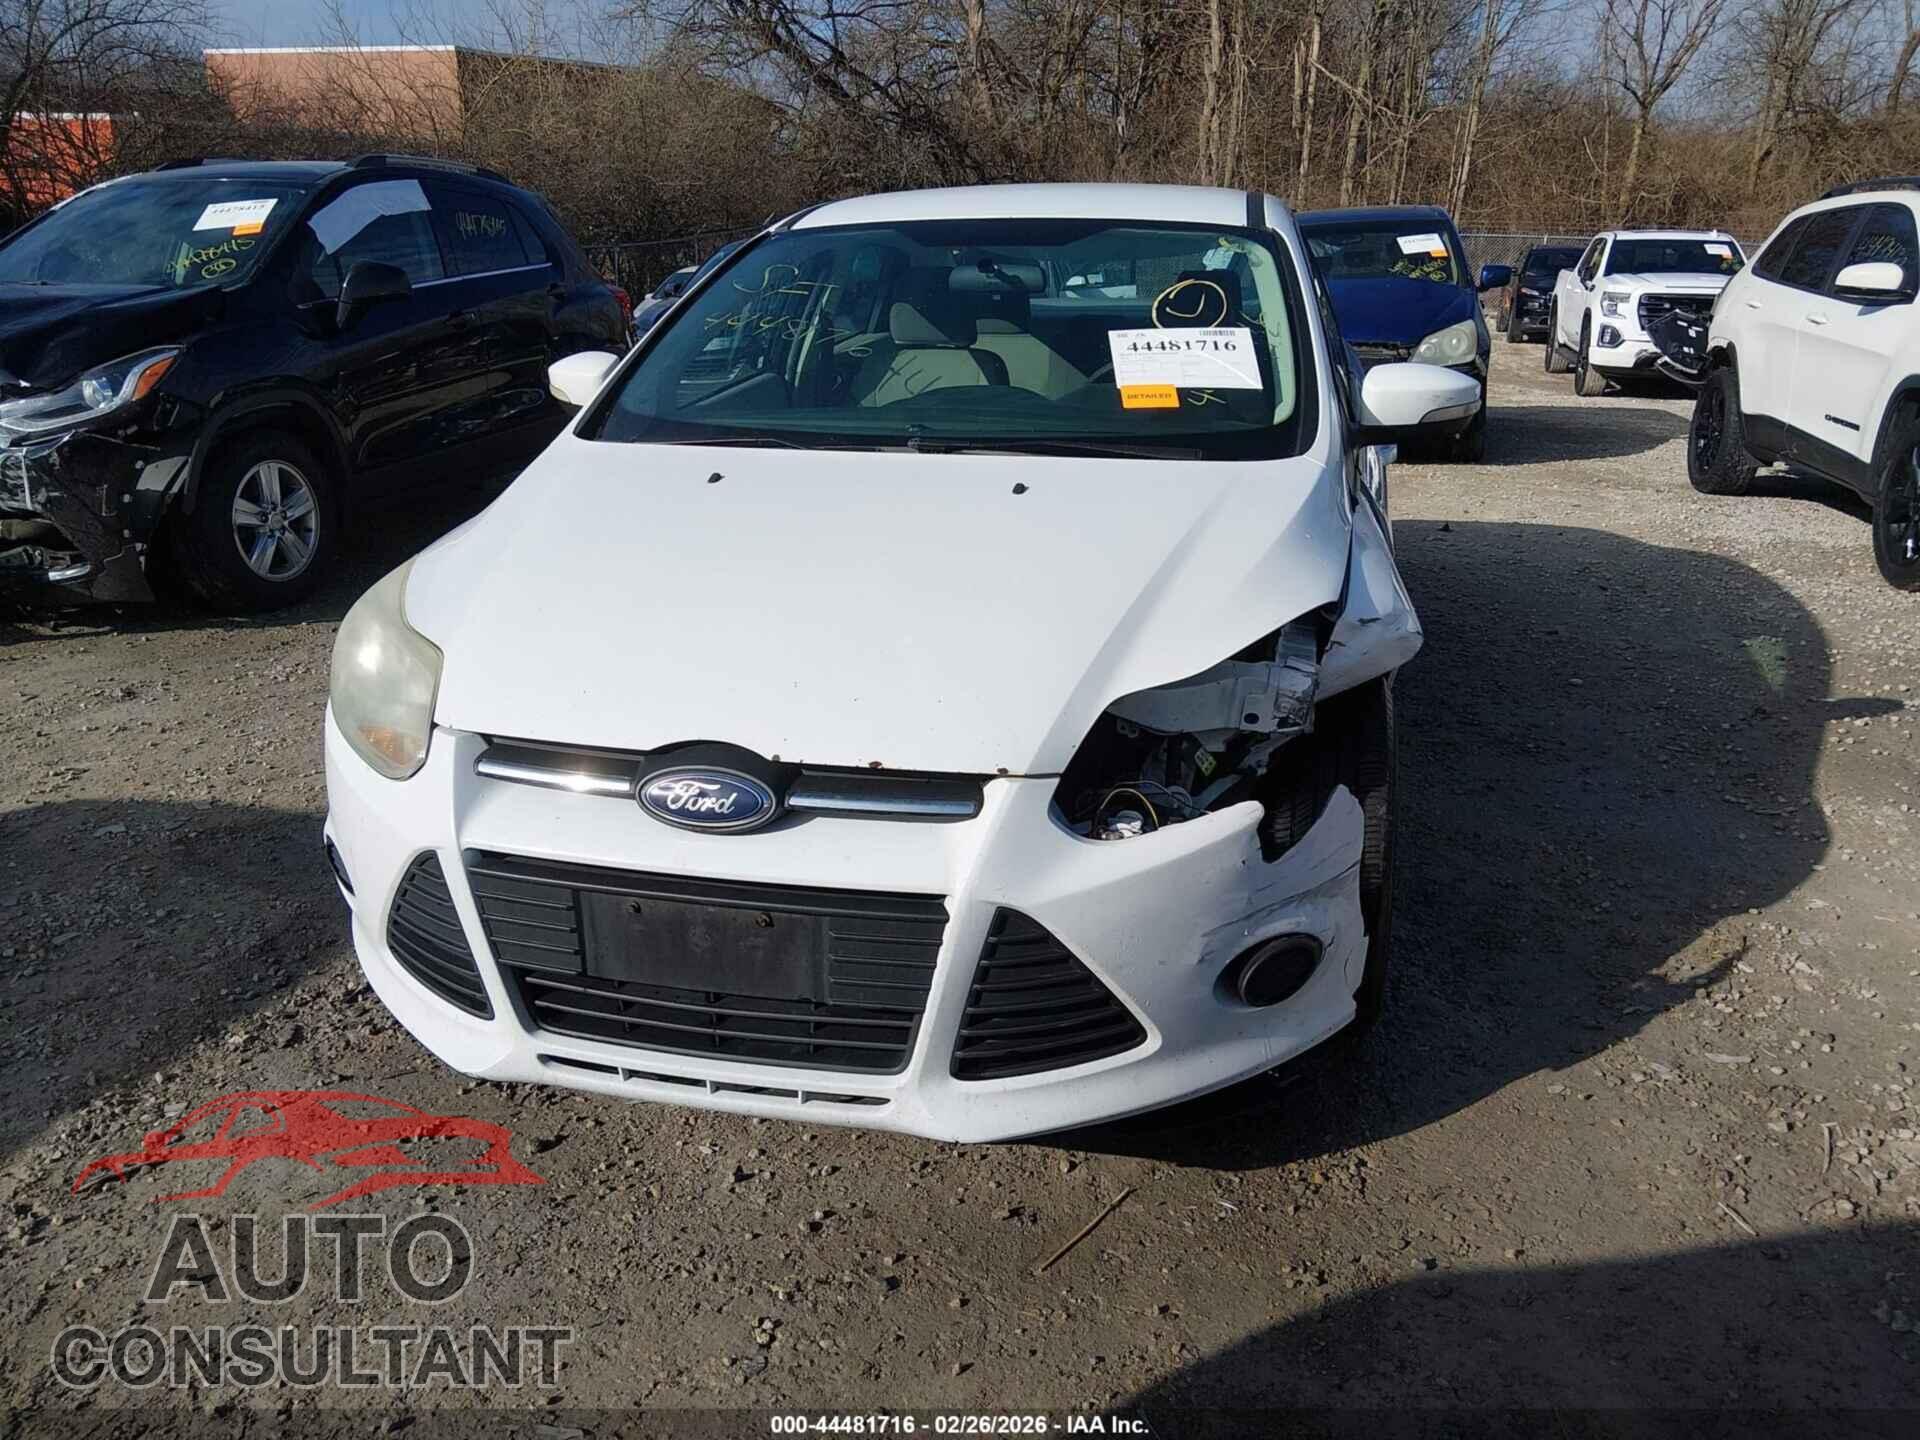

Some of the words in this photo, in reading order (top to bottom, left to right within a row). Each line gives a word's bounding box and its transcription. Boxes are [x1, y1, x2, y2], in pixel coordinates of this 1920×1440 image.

[1126, 339, 1237, 353] 44481716
[1126, 392, 1172, 400] DETAILED
[649, 780, 738, 815] Ford
